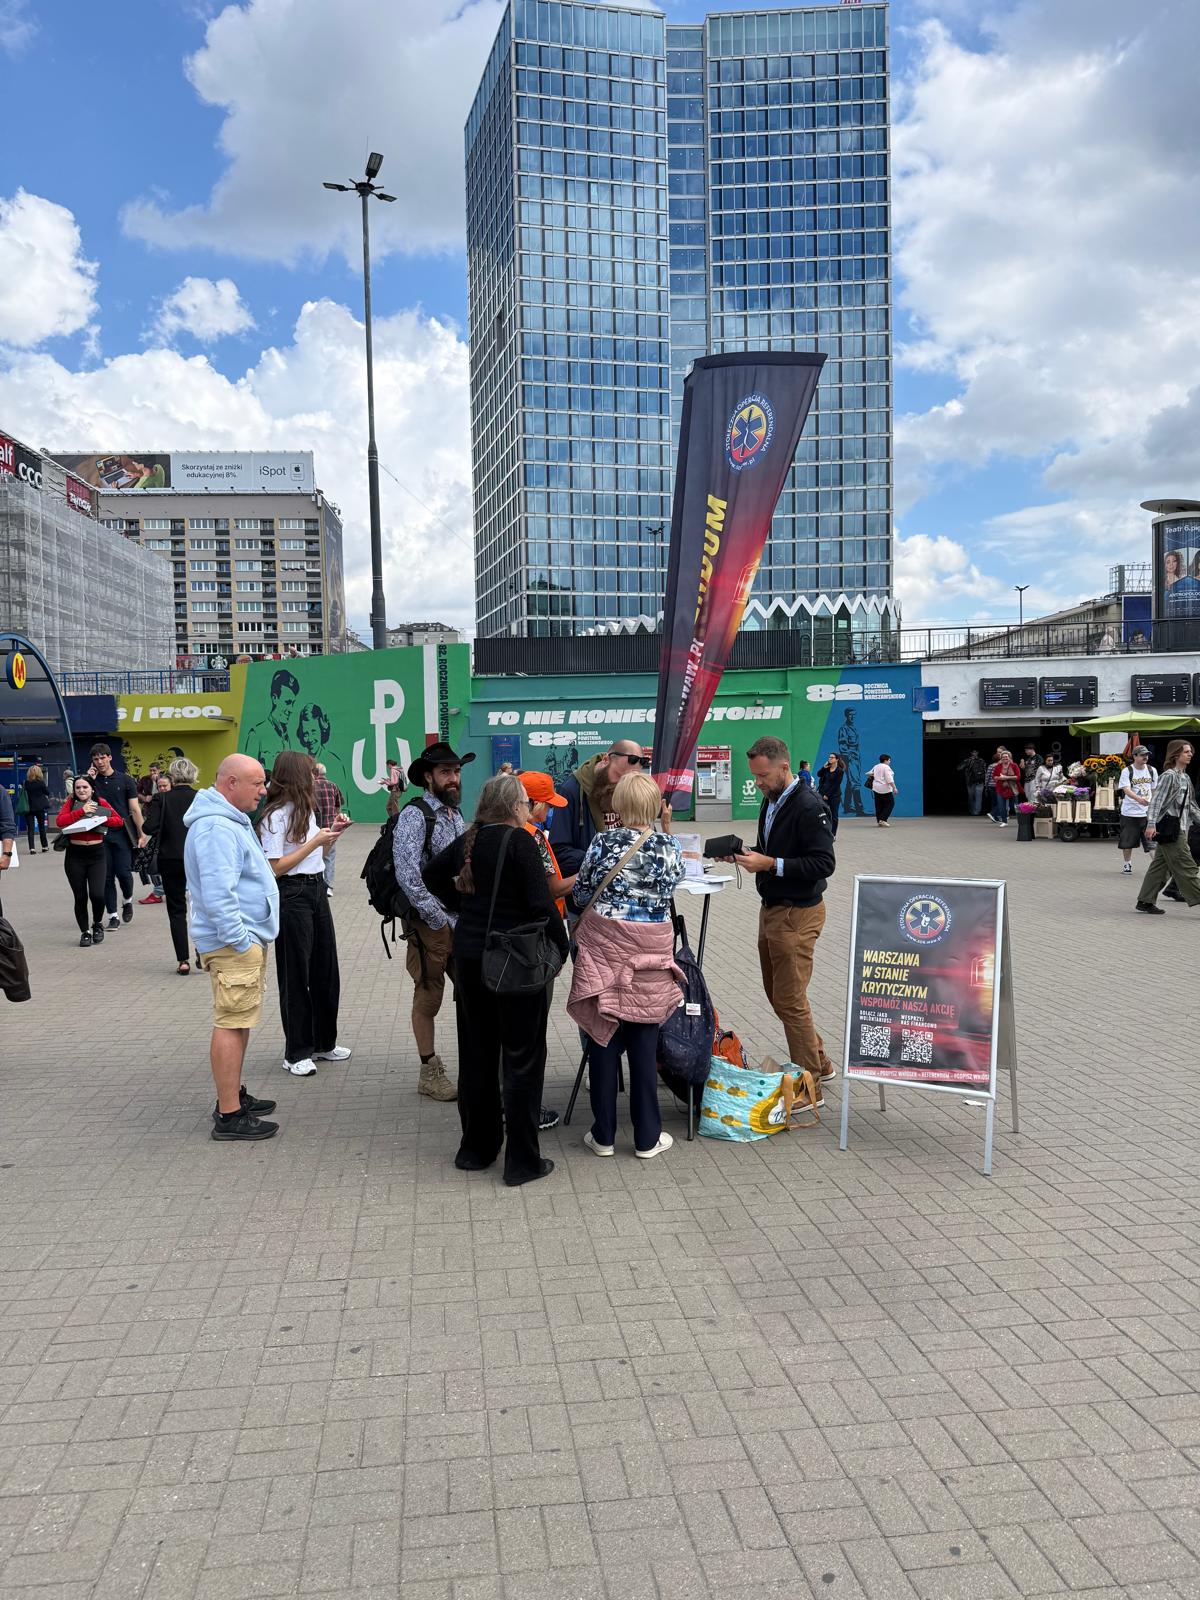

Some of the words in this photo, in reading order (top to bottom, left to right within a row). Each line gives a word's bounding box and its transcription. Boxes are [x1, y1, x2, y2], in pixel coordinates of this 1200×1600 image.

[259, 465, 287, 477] iSpot
[1166, 525, 1182, 534] Teatr
[438, 644, 447, 657] 82.
[14, 658, 25, 681] M
[439, 659, 448, 699] ROCZNICA
[806, 683, 864, 701] 82
[149, 705, 222, 720] 17:00
[487, 711, 520, 726] TO
[523, 710, 566, 725] NIE
[528, 731, 577, 746] 82
[863, 949, 920, 967] WARSZAWA
[862, 966, 873, 978] W
[874, 966, 910, 981] STANIE
[861, 980, 928, 999] KRYTYCZNYM
[859, 995, 901, 1010] WSPOMÓŻ
[902, 1000, 929, 1016] NASZĄ
[930, 1003, 956, 1018] AKCJĘ
